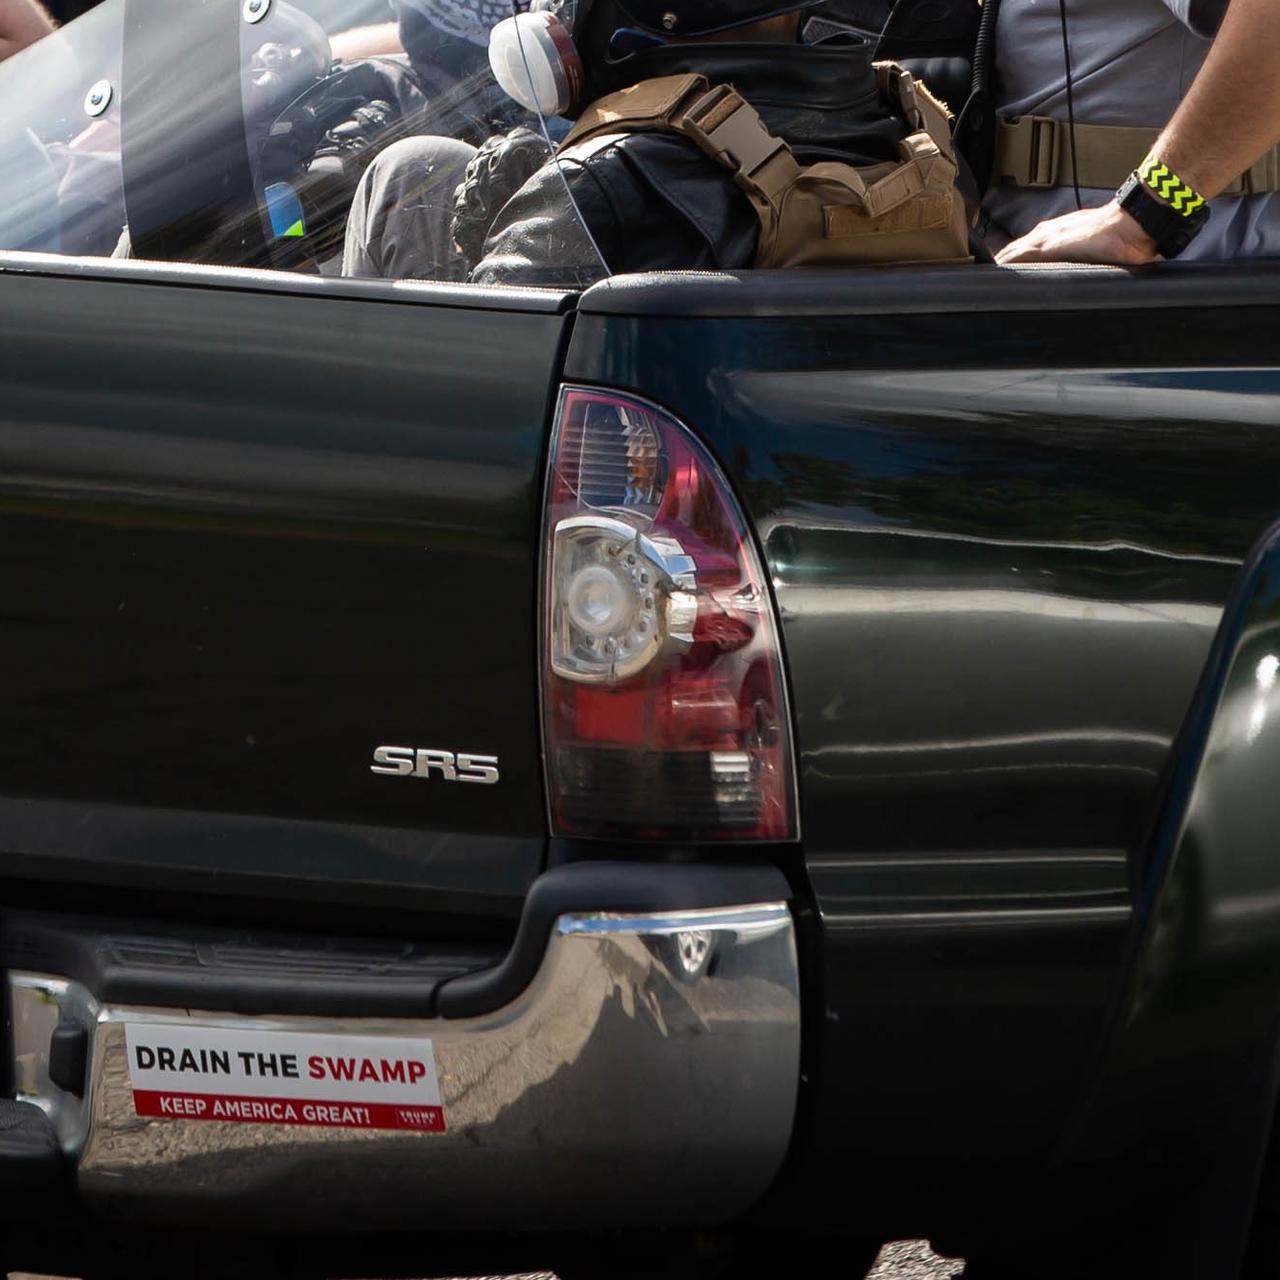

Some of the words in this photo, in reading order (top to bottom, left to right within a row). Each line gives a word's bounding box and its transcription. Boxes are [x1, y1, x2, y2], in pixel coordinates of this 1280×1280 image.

[370, 746, 499, 784] SR5
[135, 1046, 231, 1075] DRAIN
[238, 1051, 300, 1079] THE
[307, 1055, 427, 1085] SWAMP
[160, 1096, 207, 1116] KEEP
[213, 1100, 298, 1121] AMERICA
[303, 1105, 371, 1125] GREAT!
